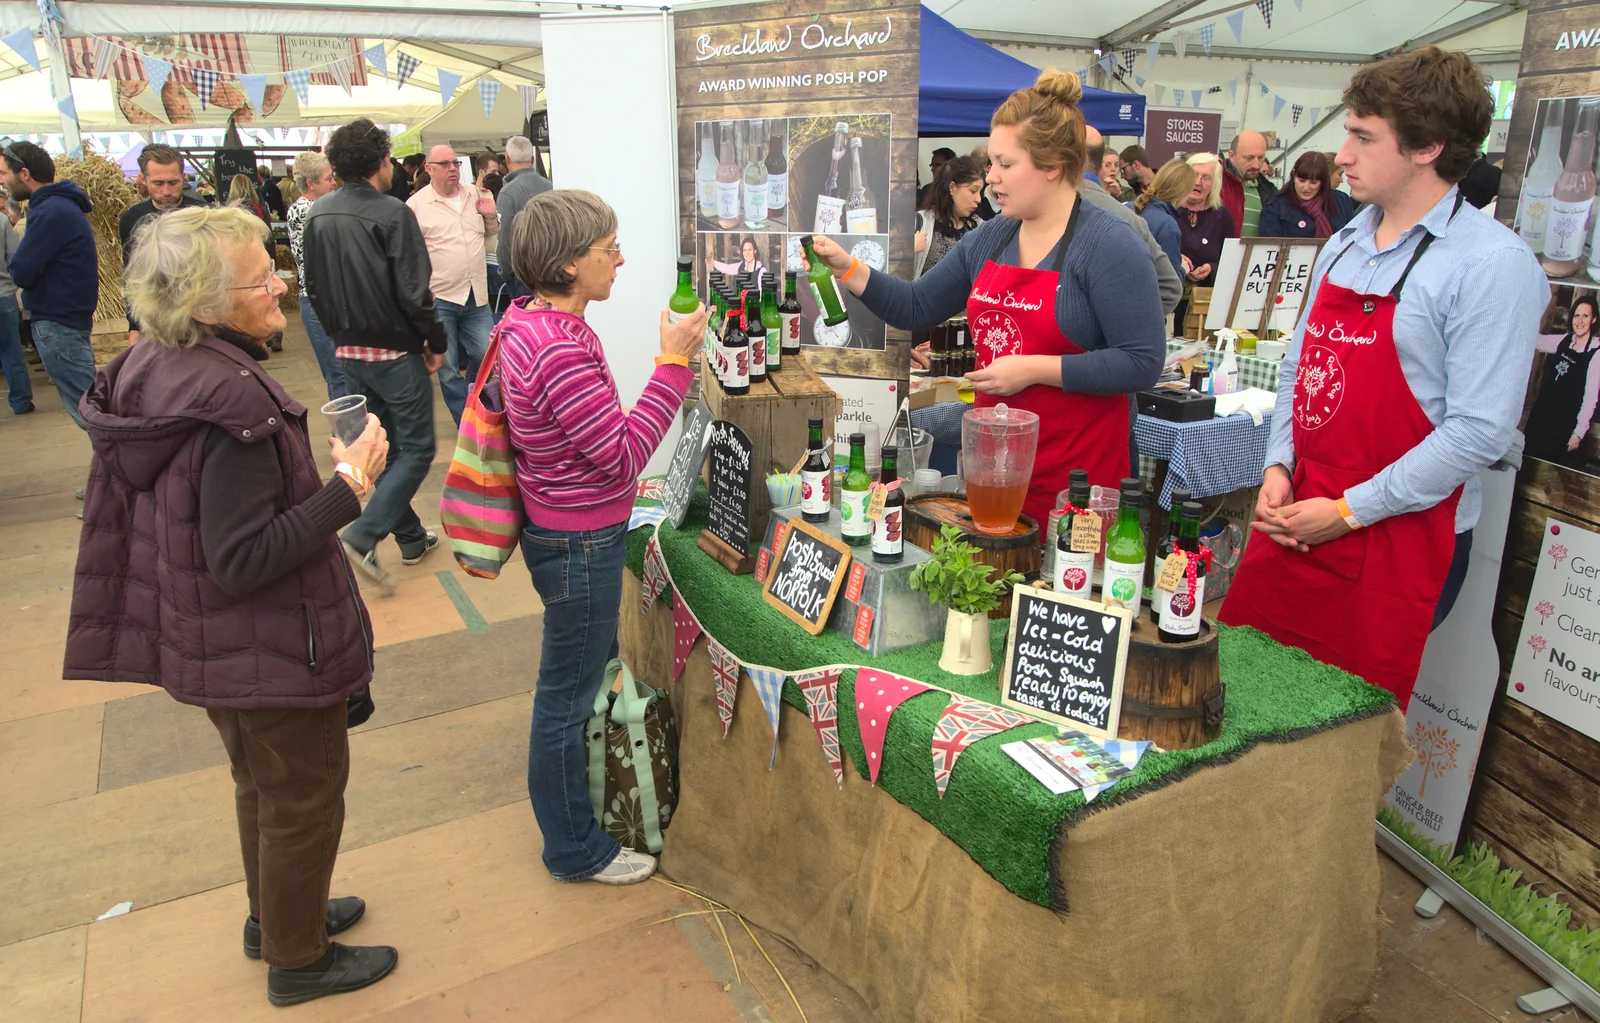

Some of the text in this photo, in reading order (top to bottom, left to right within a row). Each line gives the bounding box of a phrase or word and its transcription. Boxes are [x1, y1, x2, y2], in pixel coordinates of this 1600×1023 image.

[695, 17, 892, 61] Breckland Orchard
[698, 69, 888, 93] AWARD WINNING POSH POP
[1166, 119, 1204, 131] STOKES
[1166, 131, 1204, 143] SAUCES
[218, 153, 236, 167] Try
[238, 165, 255, 174] the
[1329, 327, 1377, 346] Orchard
[842, 397, 864, 408] ated
[836, 411, 872, 423] parkle
[783, 531, 815, 567] Posh
[772, 572, 826, 618] NORFOLK
[1563, 577, 1593, 601] just
[1029, 600, 1088, 630] We have
[1017, 656, 1052, 678] Posh
[1019, 641, 1096, 674] delicious
[1549, 648, 1576, 672] No
[1015, 673, 1111, 717] ready to enjoy
[1051, 700, 1061, 712] it
[1065, 704, 1105, 726] today!
[1411, 691, 1480, 732] reckland Orchard
[1395, 785, 1444, 825] GINGER BEER
[1395, 794, 1441, 832] WITH CHILLI
